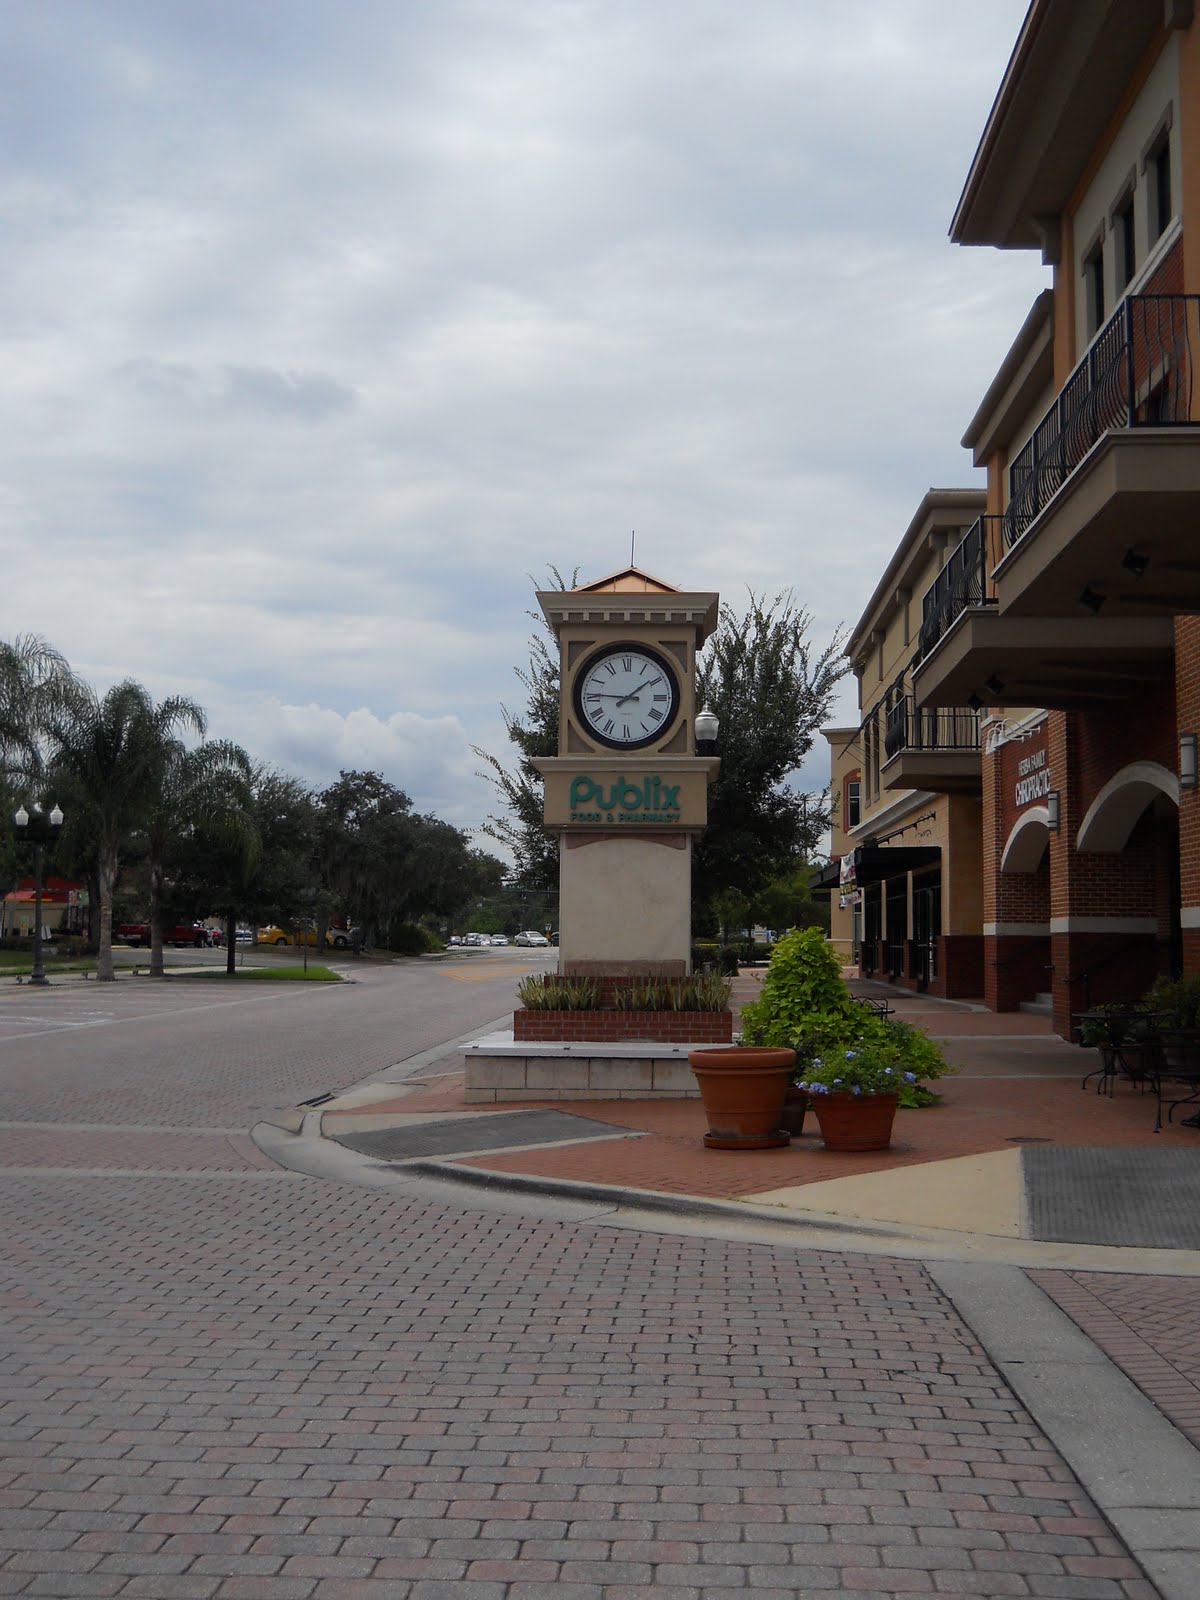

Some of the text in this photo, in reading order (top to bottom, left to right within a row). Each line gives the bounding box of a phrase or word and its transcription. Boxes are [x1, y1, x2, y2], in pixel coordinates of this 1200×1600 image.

[570, 775, 680, 810] Publix
[1016, 768, 1050, 806] CHIROPRACTIC
[570, 812, 681, 823] FOOD & PHARMACY
